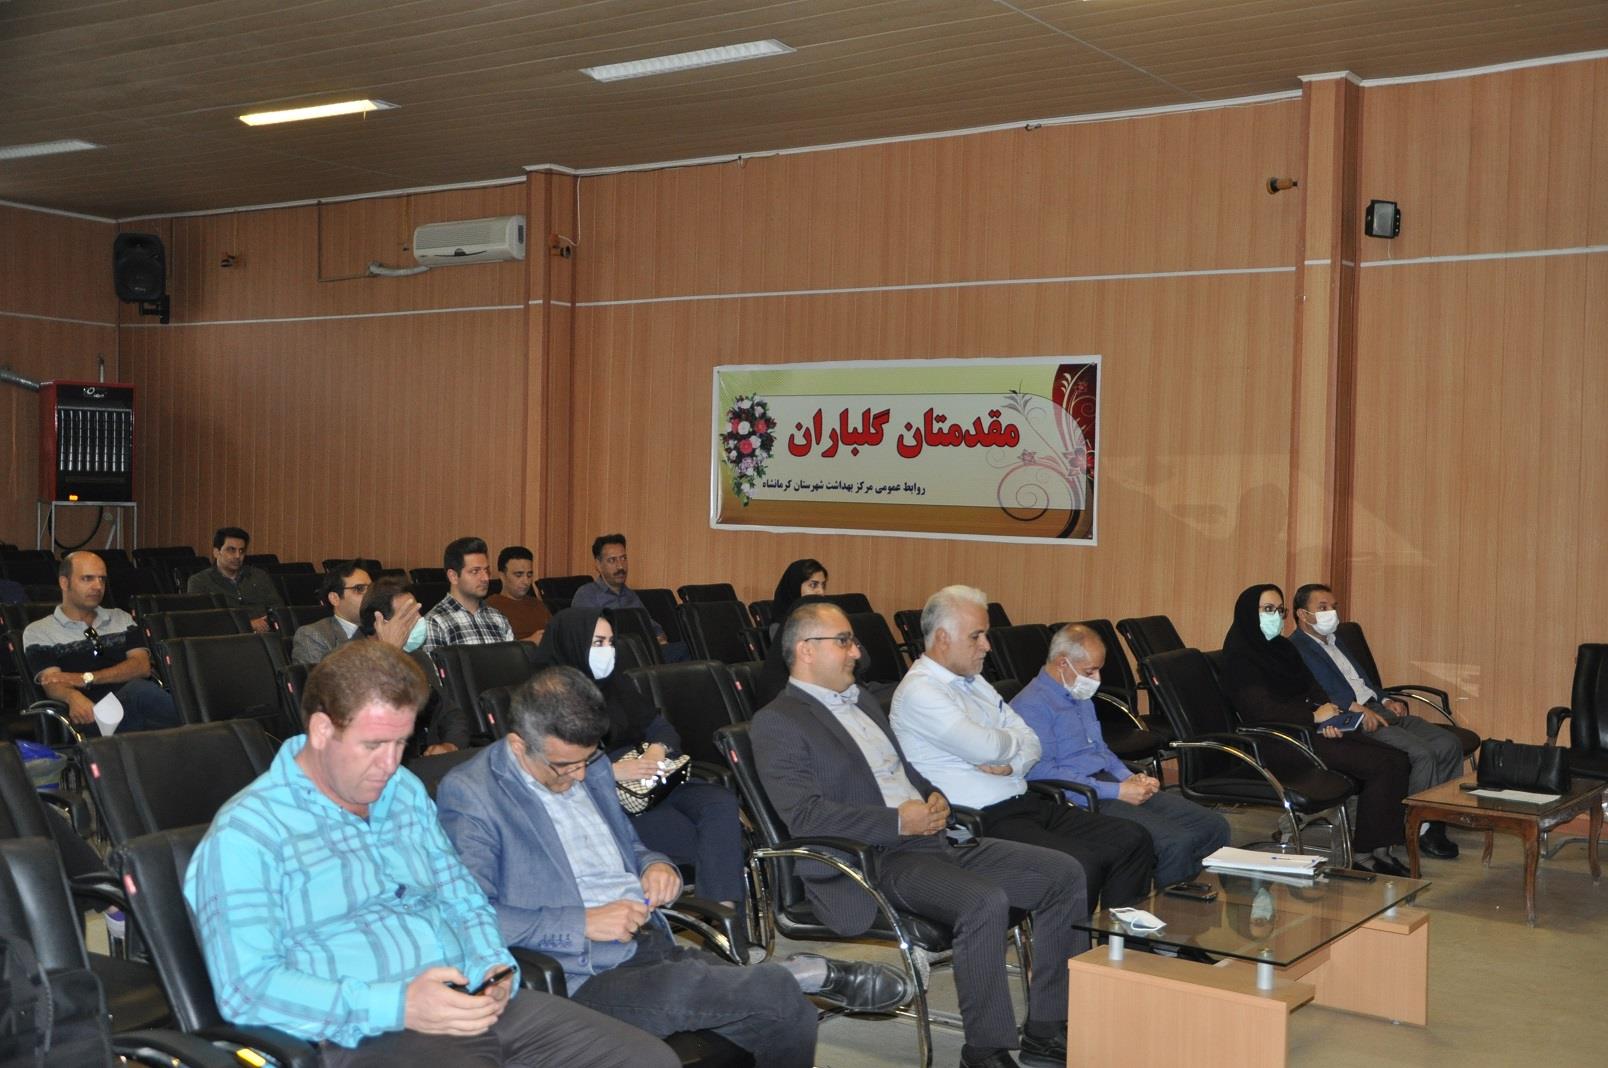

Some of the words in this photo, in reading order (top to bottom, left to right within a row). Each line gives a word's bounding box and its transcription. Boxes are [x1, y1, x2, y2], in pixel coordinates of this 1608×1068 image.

[787, 408, 891, 458] گلباران
[896, 408, 1020, 459] مقدمتان
[762, 479, 792, 492] کرمانشاه
[793, 480, 824, 492] شهرستان
[826, 480, 854, 492] بهداشت
[855, 481, 873, 494] مرکز
[875, 483, 901, 494] عمومی
[903, 482, 926, 496] روابط
